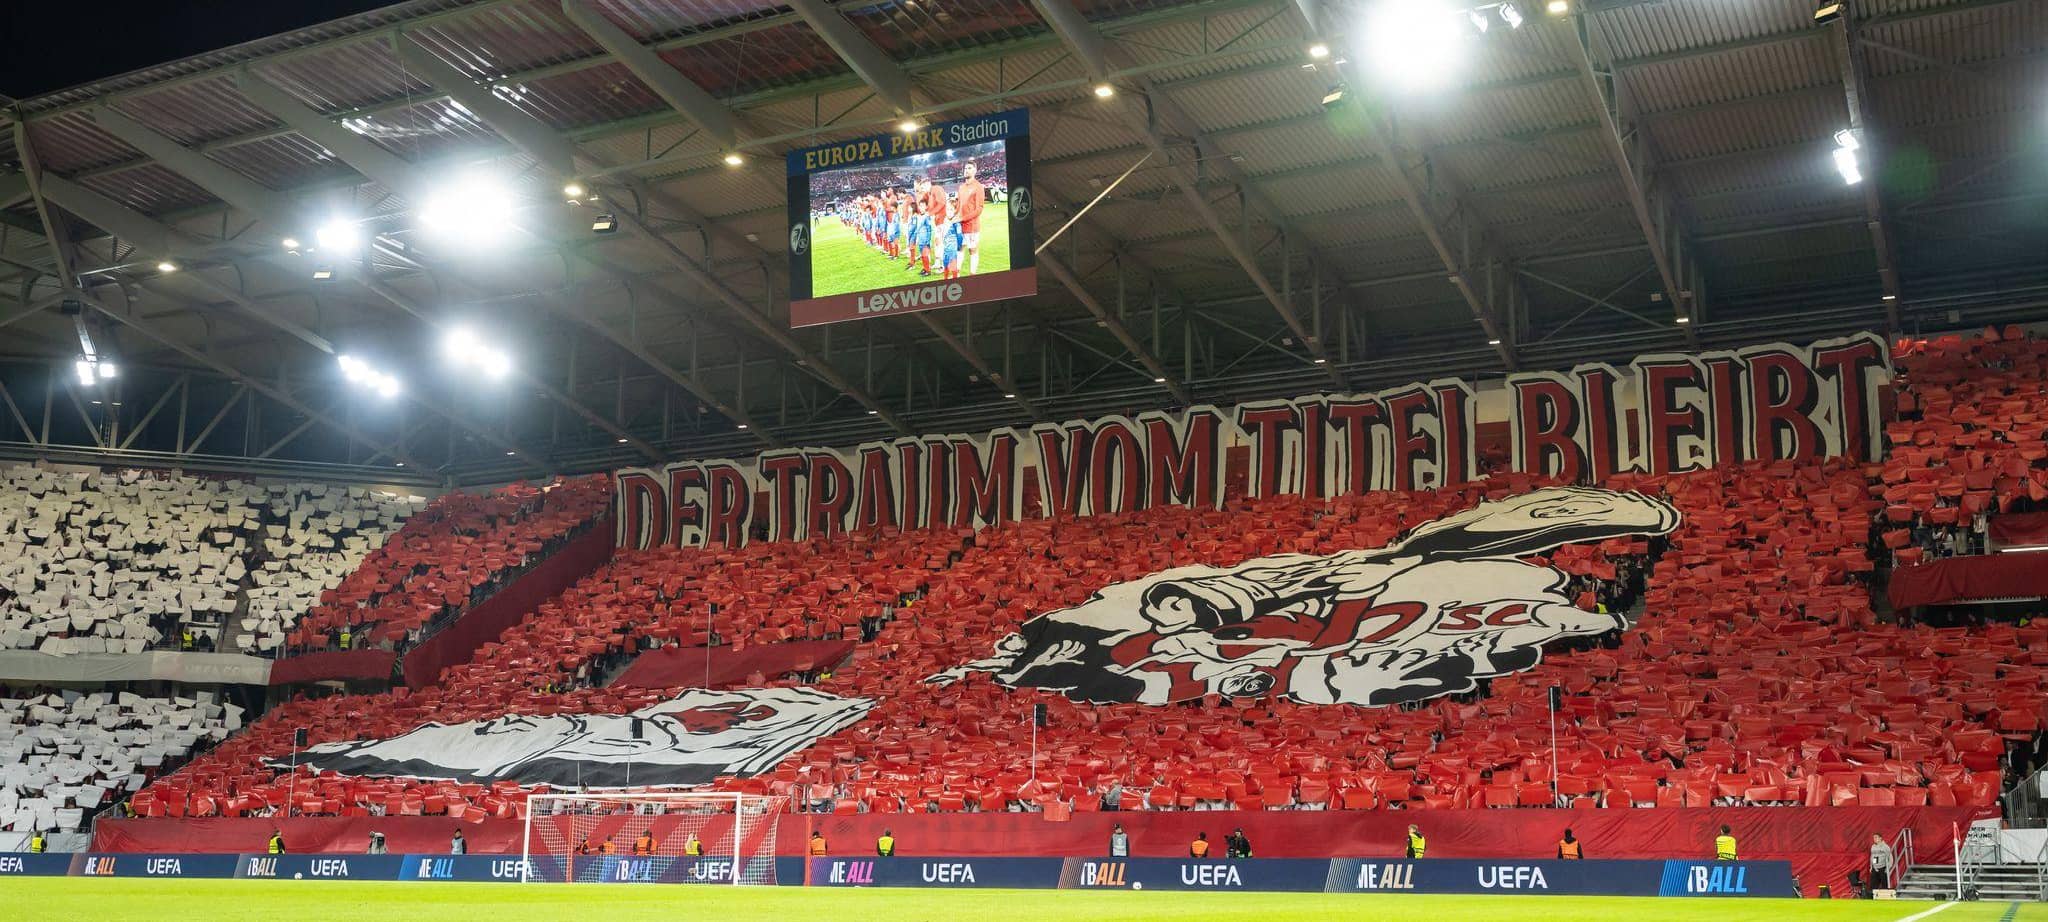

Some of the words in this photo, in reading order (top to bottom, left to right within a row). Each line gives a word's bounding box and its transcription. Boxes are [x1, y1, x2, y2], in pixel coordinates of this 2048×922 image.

[806, 139, 883, 170] EUROPA
[892, 127, 944, 154] PARK
[950, 118, 1008, 144] Stadion
[858, 282, 963, 314] Lexware
[617, 464, 750, 550] DER
[759, 432, 1019, 545] TRAUM
[1033, 410, 1223, 518] VOM
[1237, 384, 1475, 500] TITEL
[1509, 336, 1888, 486] BLEIBT
[96, 857, 116, 875] ALL
[146, 858, 182, 875] UEFA
[310, 859, 349, 876] UEFA
[431, 858, 454, 878] ALL
[845, 861, 875, 884] ALL
[922, 863, 976, 883] UEFA
[1181, 864, 1242, 886] UEFA
[1378, 864, 1415, 889] ALL
[1477, 865, 1549, 890] UEFA
